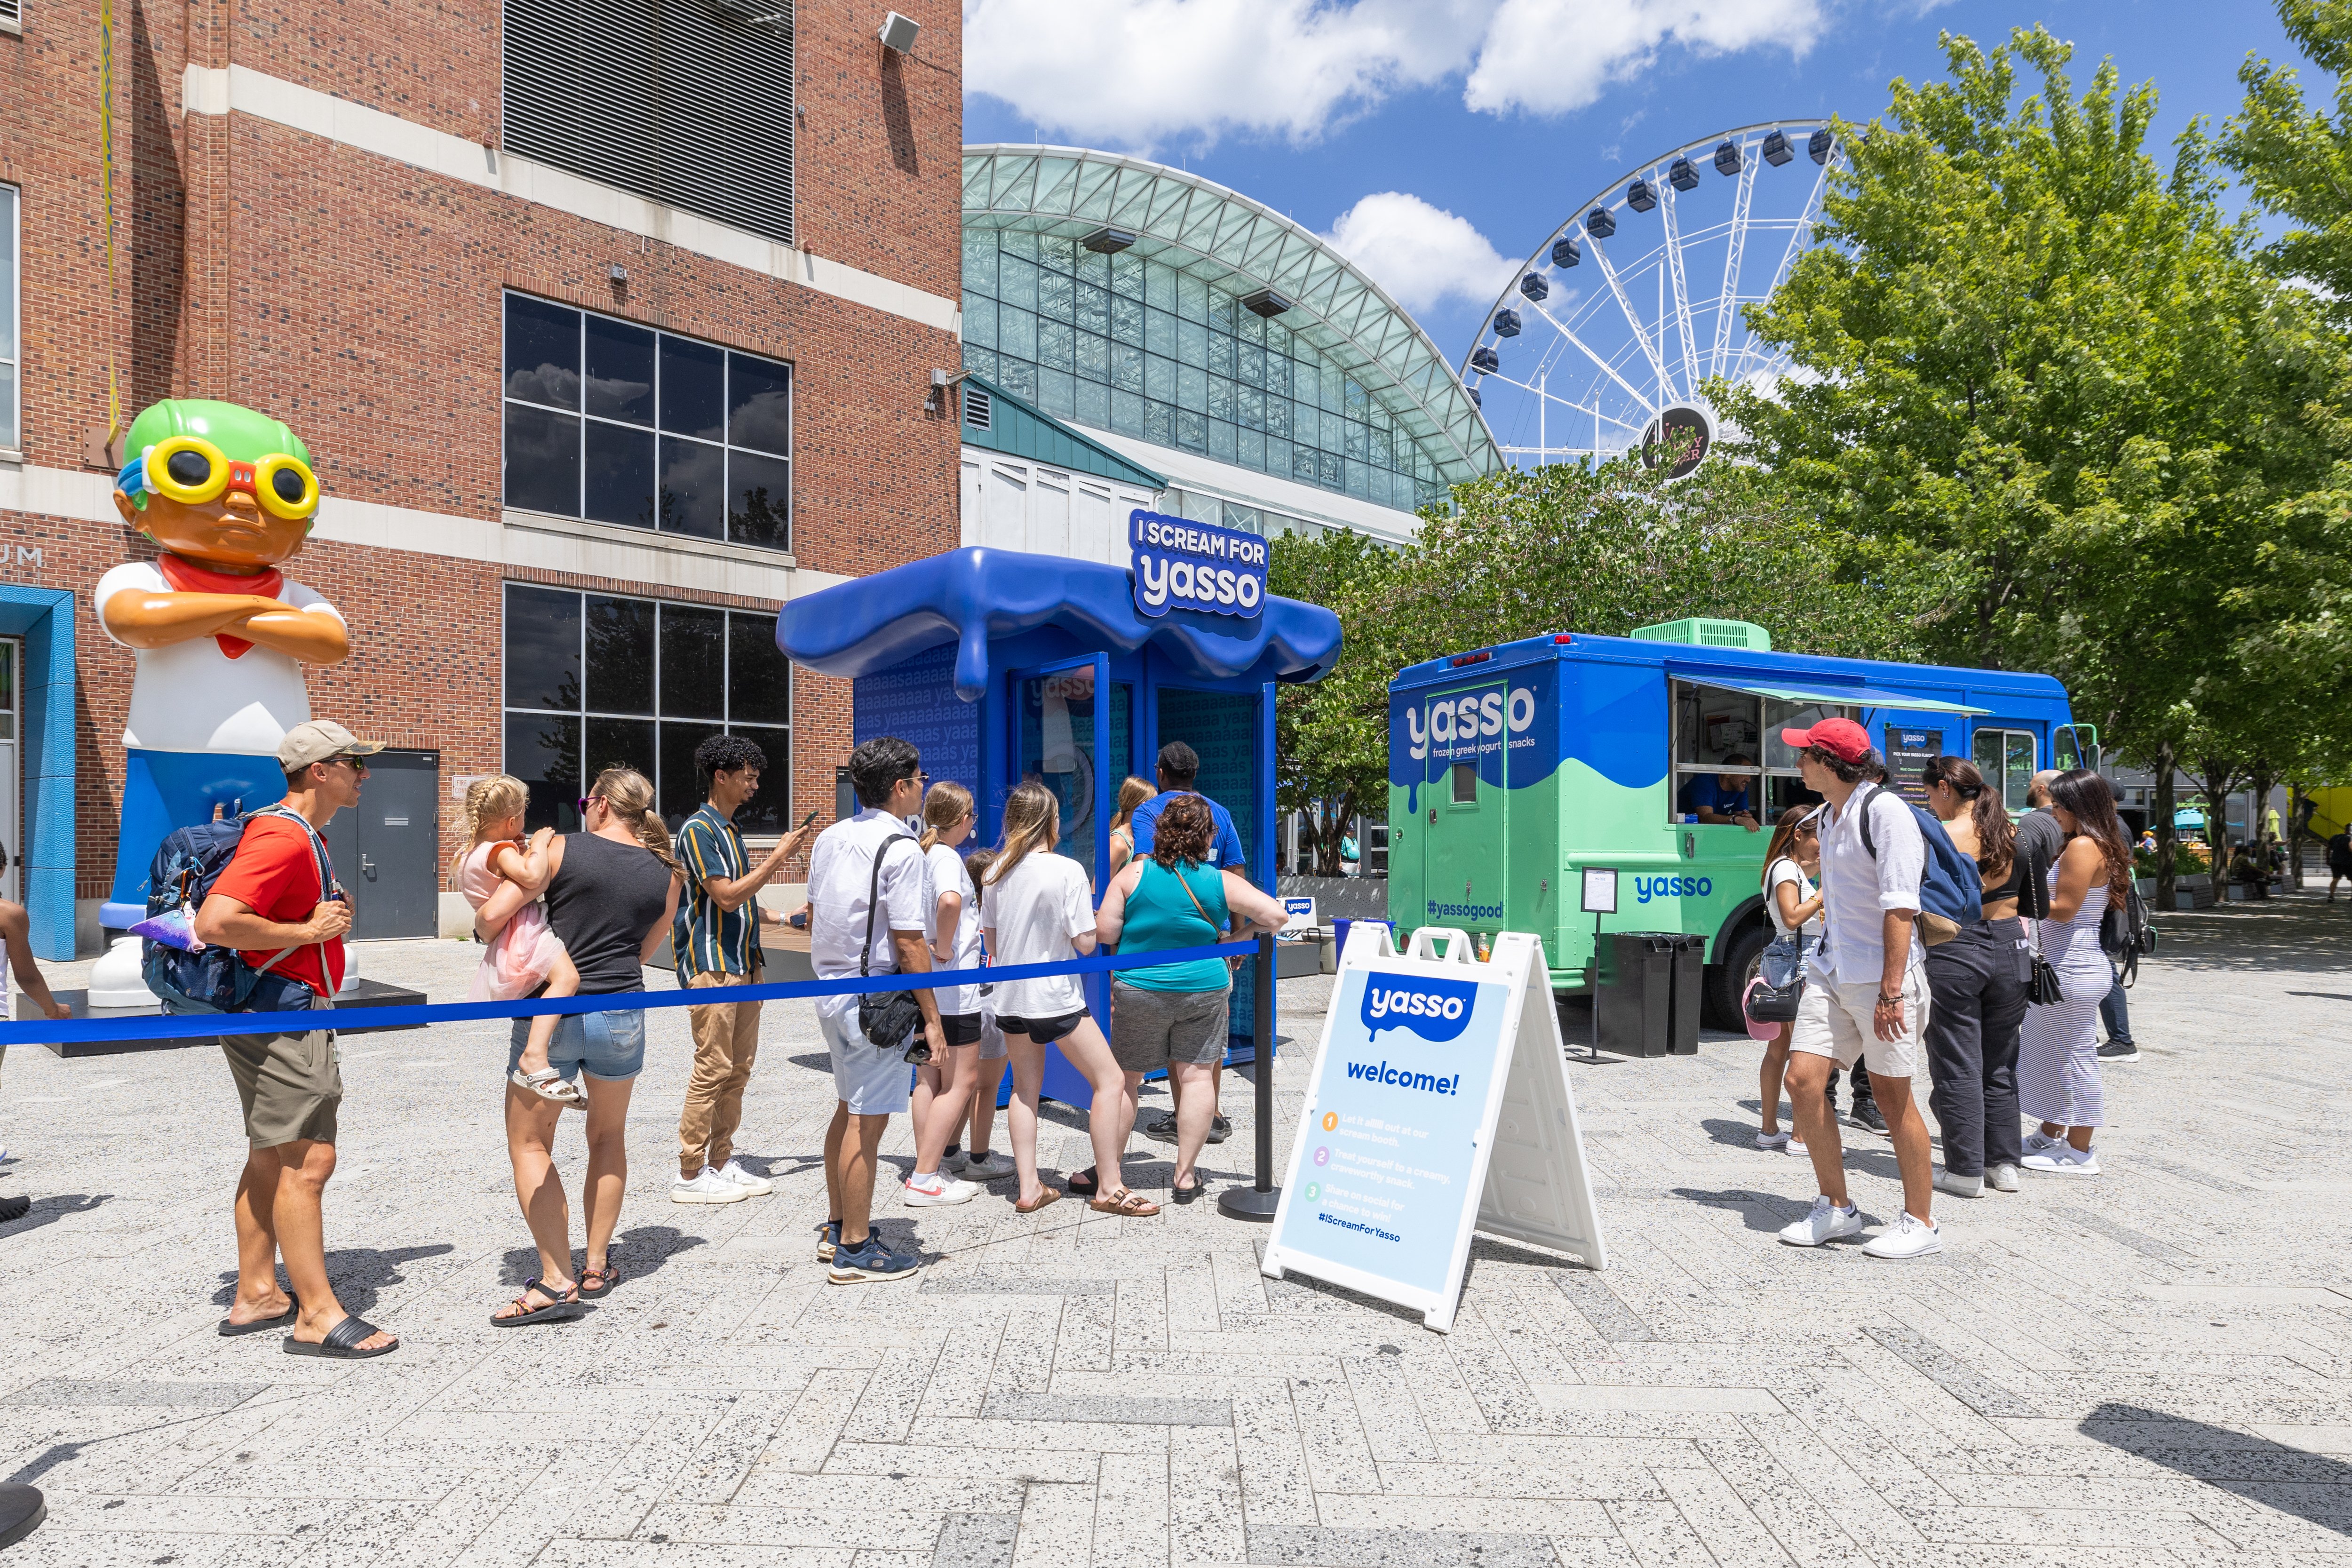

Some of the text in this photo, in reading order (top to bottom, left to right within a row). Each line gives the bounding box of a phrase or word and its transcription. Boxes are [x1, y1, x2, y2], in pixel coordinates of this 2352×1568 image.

[1137, 519, 1265, 565] I SCREAM FOR
[1140, 555, 1260, 608] yasso
[1406, 688, 1535, 760] yasso
[1433, 736, 1535, 758] frozen greek yogurt snacks
[1902, 734, 1925, 743] yasso
[1635, 876, 1712, 904] yasso
[1287, 902, 1310, 912] yasso
[1428, 900, 1503, 922] #yassogood
[1370, 988, 1463, 1020] yasso
[1348, 1060, 1460, 1096] welcome!
[1327, 1116, 1334, 1127] 1
[1342, 1114, 1356, 1124] Let
[1357, 1116, 1364, 1126] it
[1385, 1123, 1400, 1133] out
[1401, 1127, 1412, 1135] at
[1413, 1130, 1429, 1139] our
[1339, 1129, 1400, 1147] scream booth.
[1317, 1151, 1326, 1162] 2
[1334, 1148, 1356, 1161] Treat
[1356, 1154, 1394, 1170] yourself
[1395, 1162, 1405, 1173] to
[1413, 1168, 1451, 1185] creamy,
[1330, 1162, 1415, 1190] craveworthy snack.
[1308, 1186, 1317, 1197] 3
[1325, 1183, 1406, 1212] Share on social for
[1328, 1199, 1360, 1215] chance
[1361, 1207, 1371, 1218] to
[1372, 1211, 1392, 1223] win!
[1318, 1212, 1400, 1242] #IScreamForYasso
